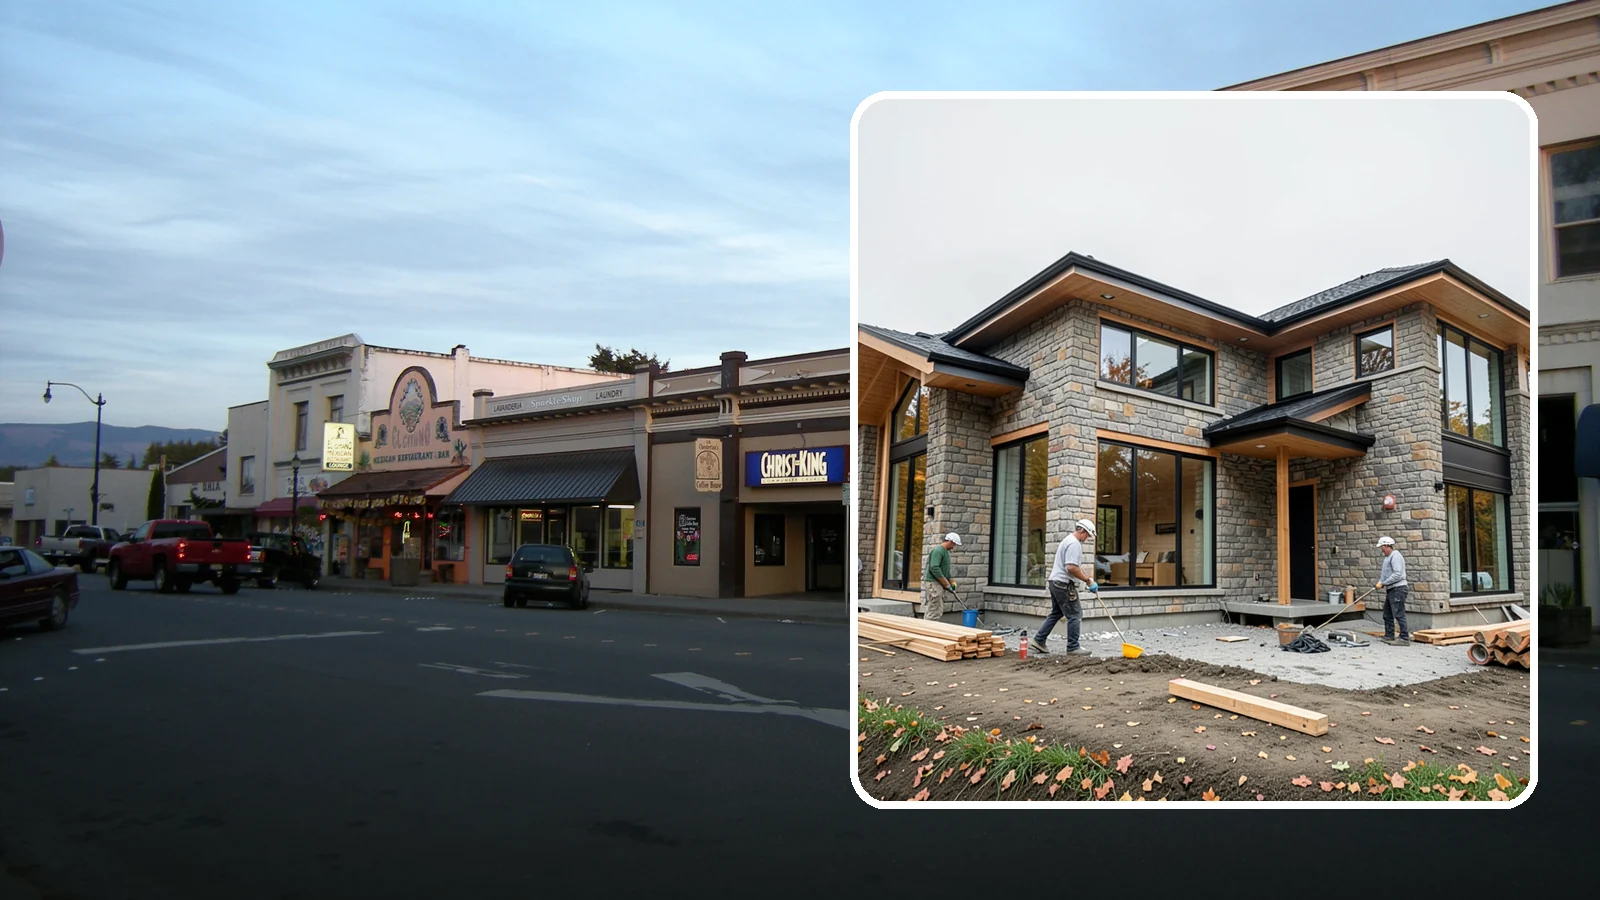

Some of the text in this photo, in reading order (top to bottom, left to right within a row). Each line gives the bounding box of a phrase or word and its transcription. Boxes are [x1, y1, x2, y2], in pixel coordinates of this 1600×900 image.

[595, 389, 623, 399] LAUNDRY
[562, 395, 582, 405] Shop
[493, 402, 522, 412] LAVANDERIA
[398, 451, 433, 462] RESTAURANT
[438, 450, 450, 458] BAR
[761, 450, 827, 478] CHRIST KING
